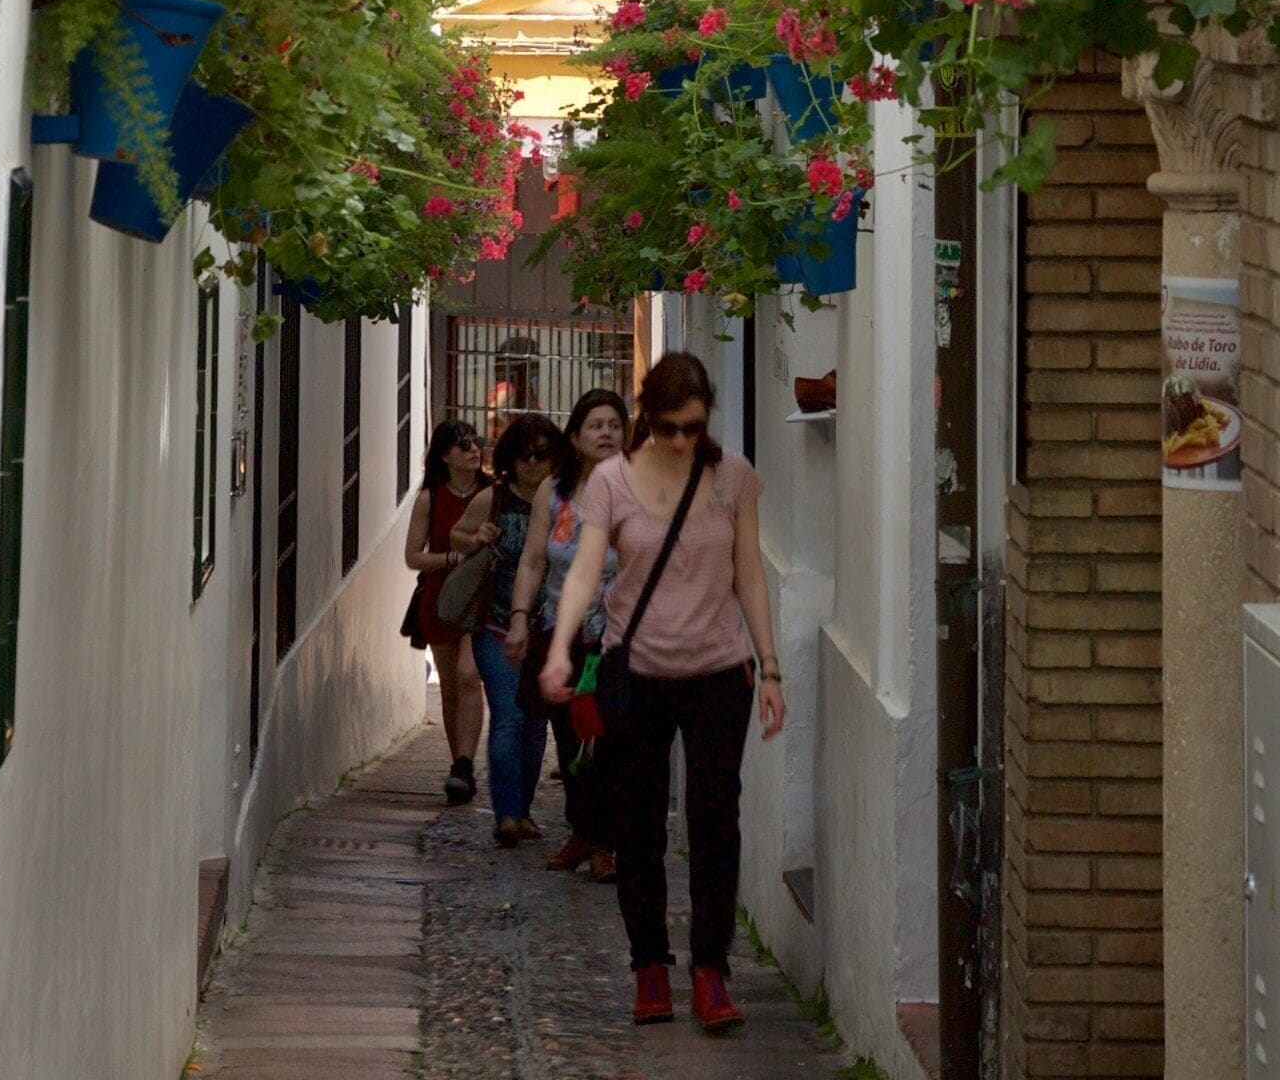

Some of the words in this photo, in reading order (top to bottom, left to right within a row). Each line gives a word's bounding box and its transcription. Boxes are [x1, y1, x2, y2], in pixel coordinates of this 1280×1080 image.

[1191, 337, 1205, 352] de
[1209, 338, 1237, 353] Toro
[1175, 355, 1187, 370] de
[1188, 357, 1221, 372] Lidia.
